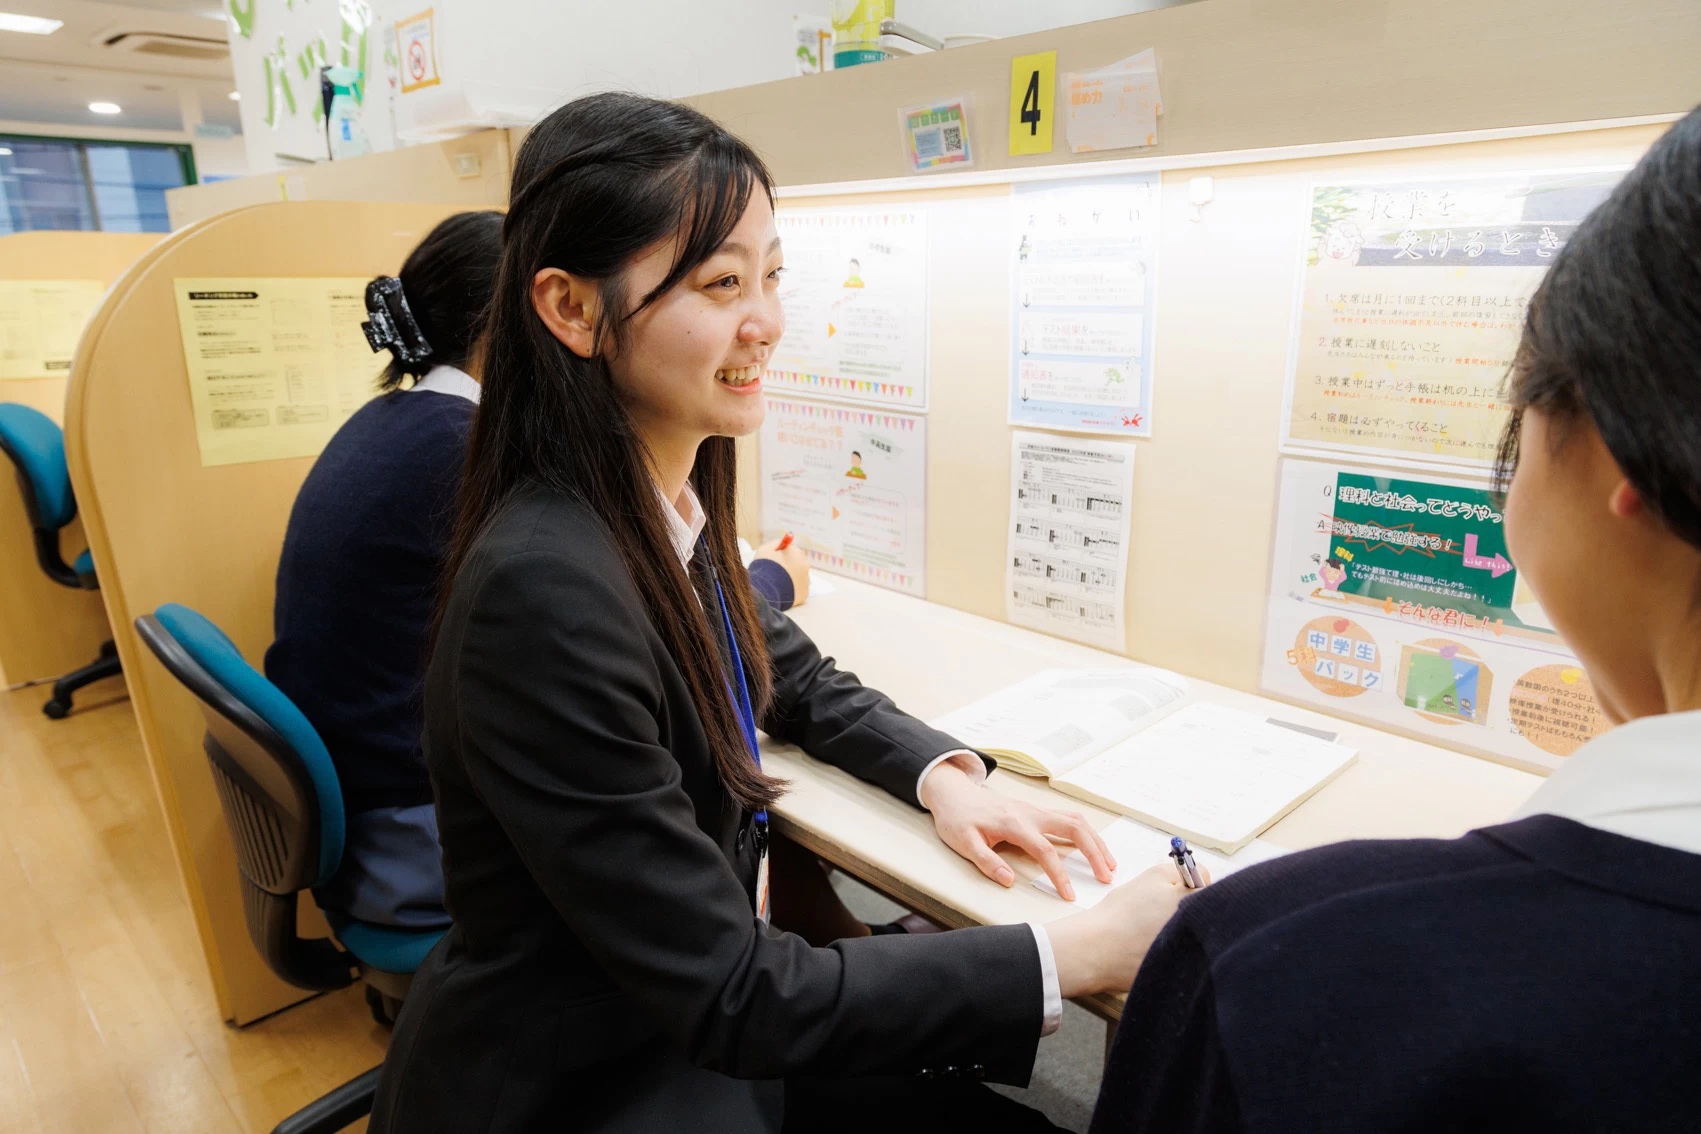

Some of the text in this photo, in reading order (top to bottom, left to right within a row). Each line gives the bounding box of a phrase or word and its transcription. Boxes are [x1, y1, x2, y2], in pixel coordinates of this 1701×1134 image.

[1020, 70, 1041, 136] 4
[1368, 190, 1456, 221] 授業を
[1393, 226, 1566, 260] 受けるとき
[1331, 337, 1441, 353] 授業に遅刻しないこと
[1327, 412, 1448, 435] 宿題は必ずやってくること
[1338, 486, 1504, 523] 理科と社会ってどうやっ
[1398, 599, 1489, 632] そんな君に！
[1286, 645, 1318, 666] 5科
[1309, 632, 1374, 662] 中学生
[1315, 660, 1380, 688] パック
